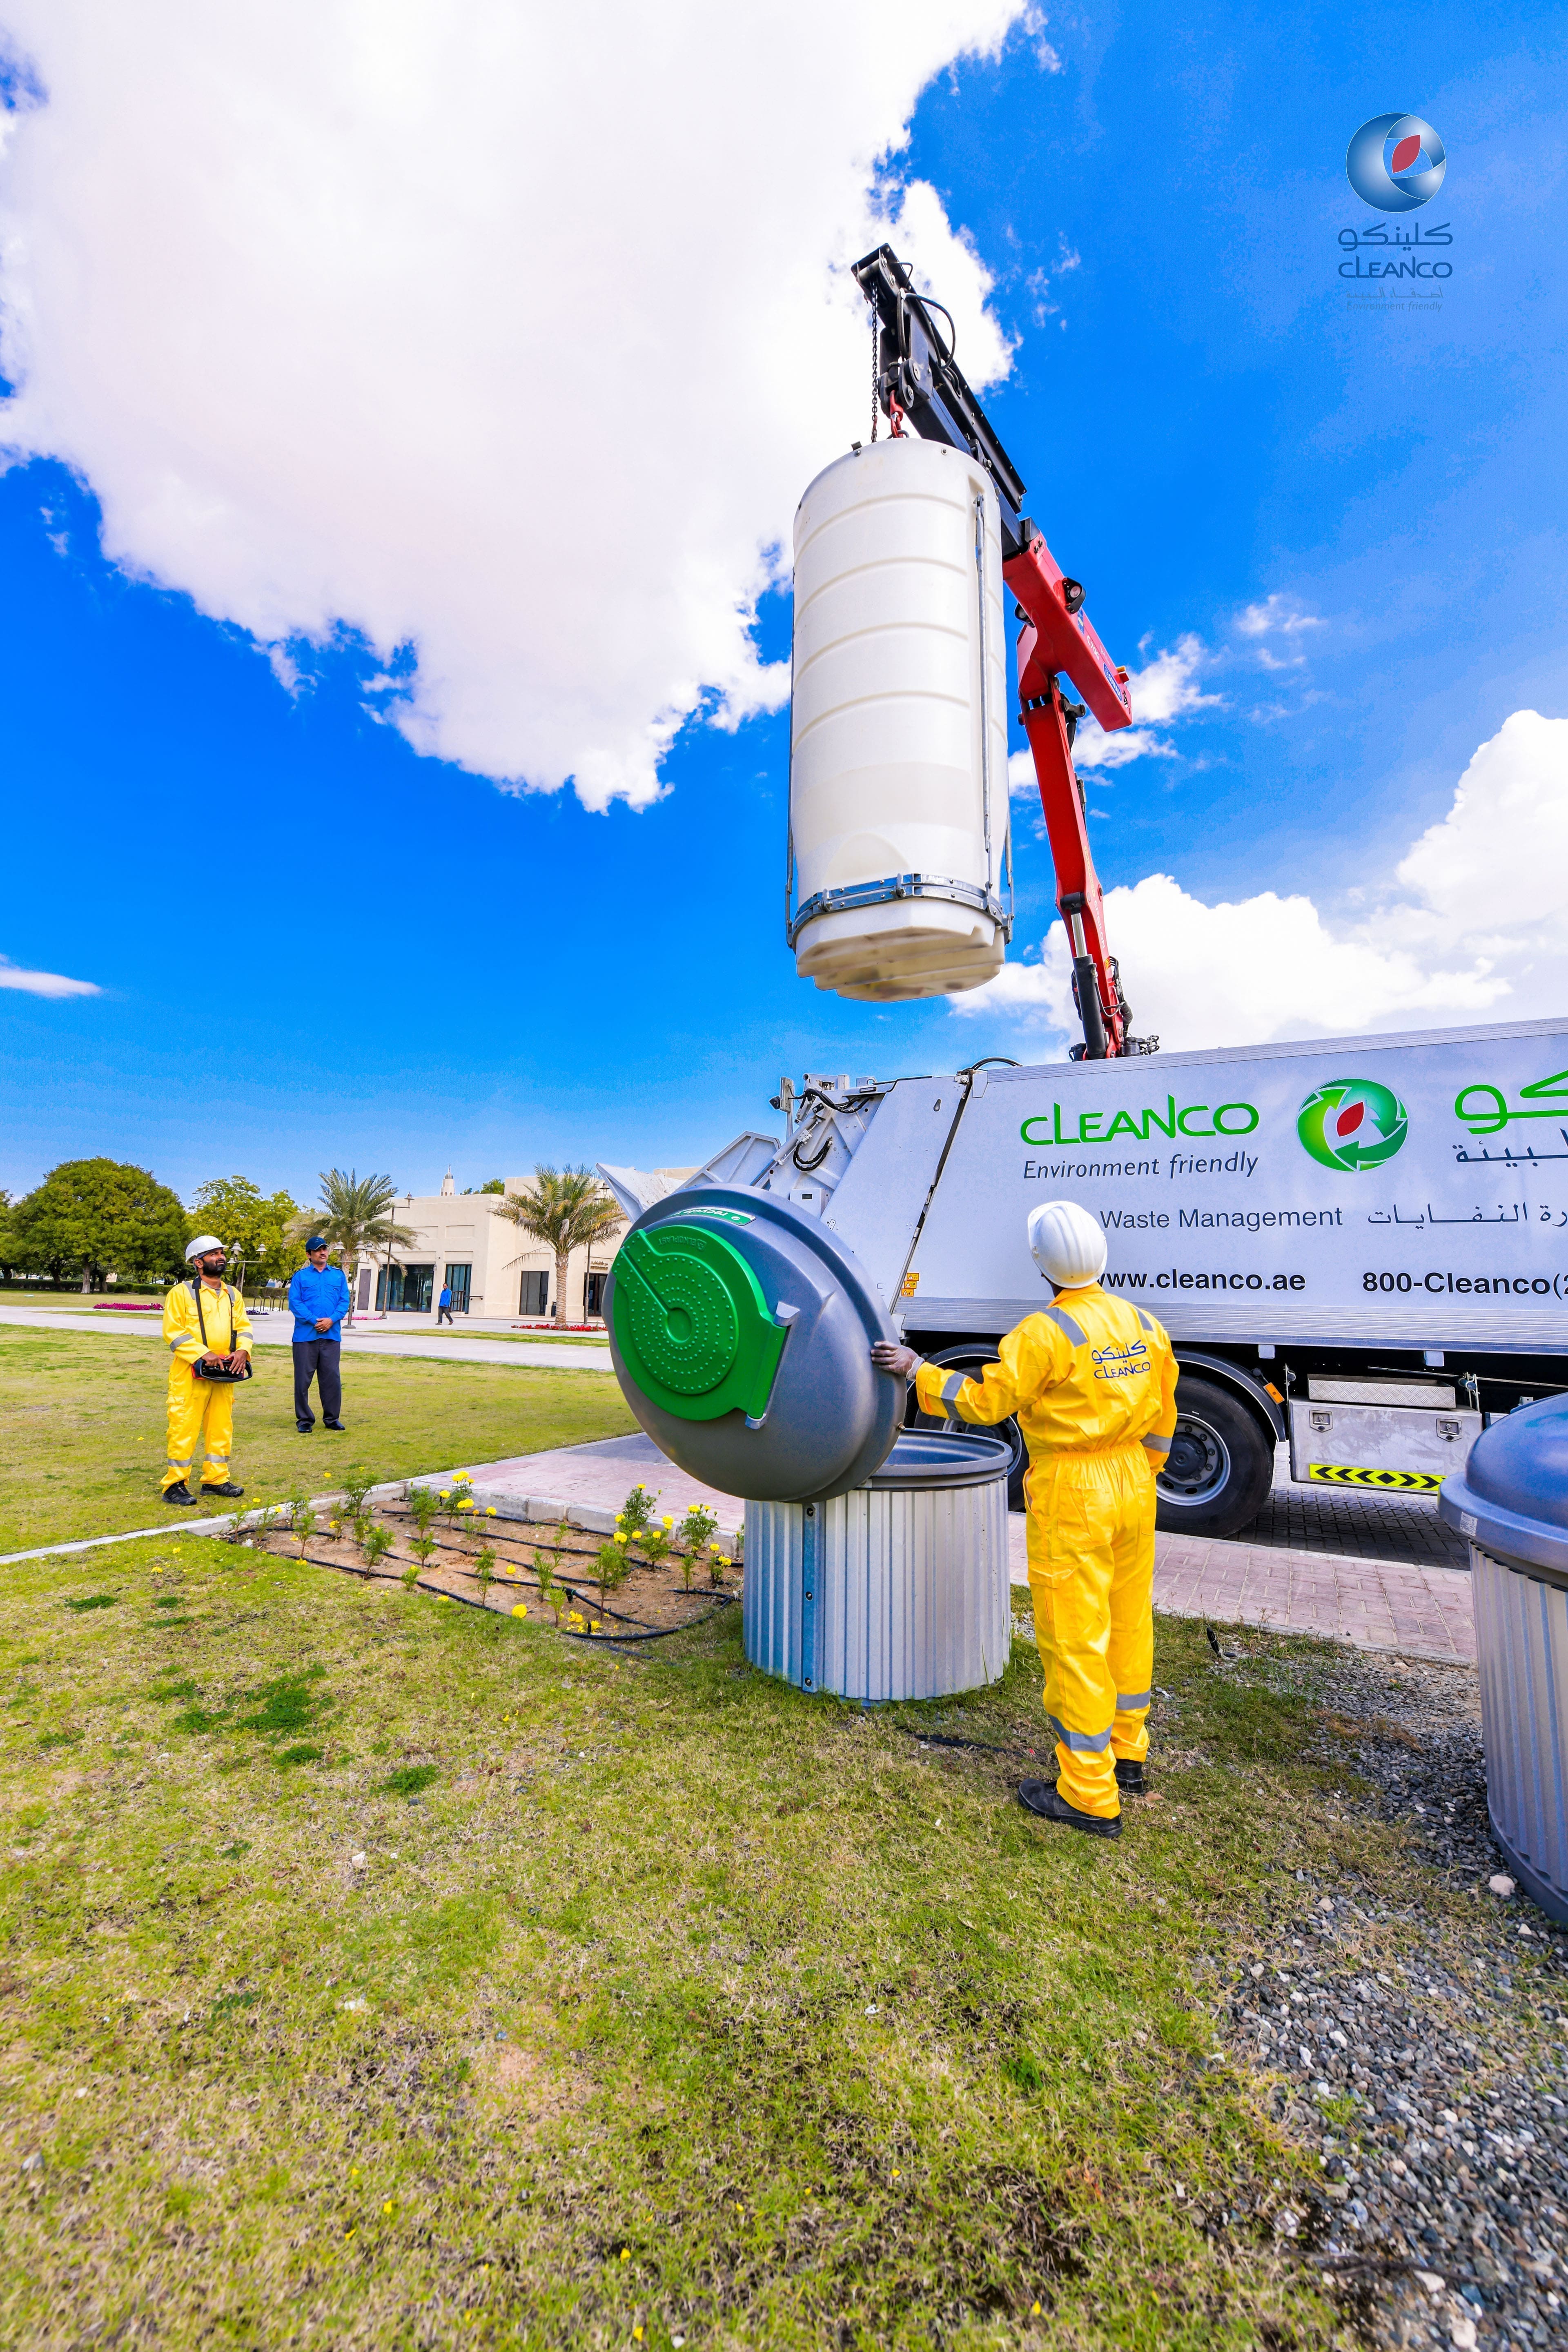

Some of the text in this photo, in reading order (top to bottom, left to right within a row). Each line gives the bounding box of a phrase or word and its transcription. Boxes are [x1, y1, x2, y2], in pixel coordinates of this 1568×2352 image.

[1021, 1095, 1259, 1145] CLEANCO
[1024, 1152, 1258, 1179] Environment friendly
[1100, 1207, 1343, 1232] Waste Management
[1091, 1339, 1147, 1365] كلينكو
[1094, 1362, 1151, 1379] CLEANCO
